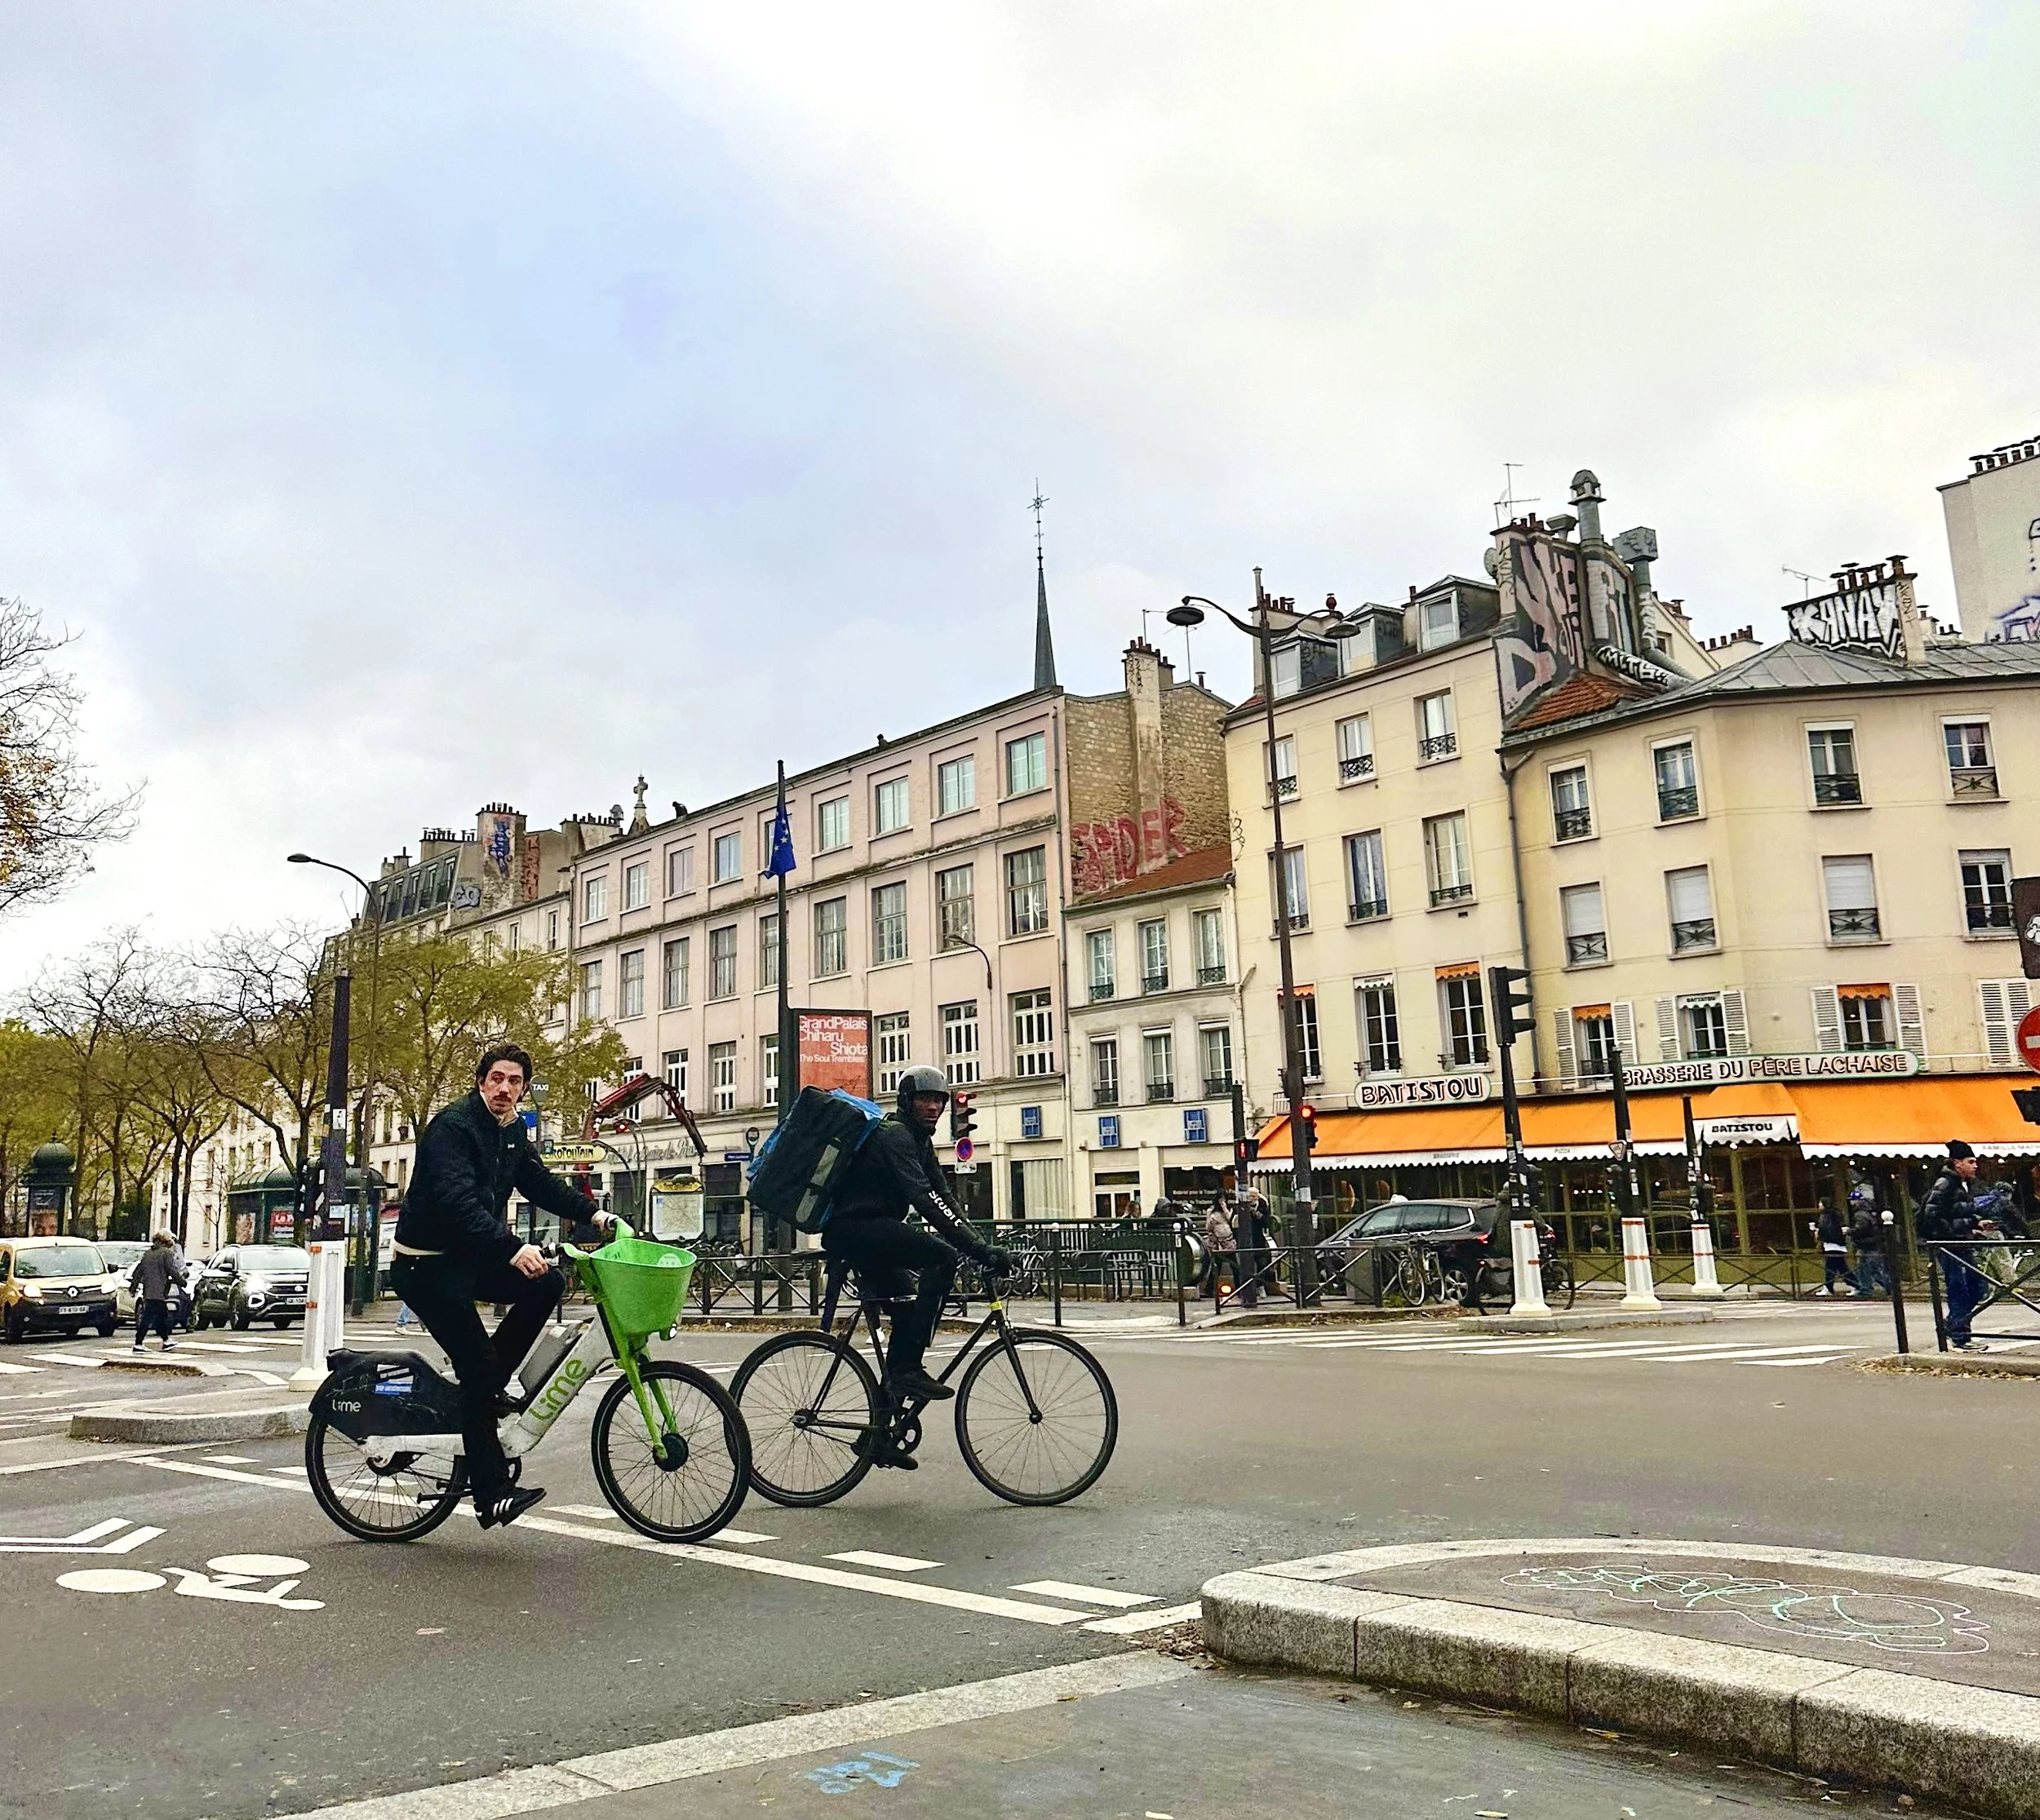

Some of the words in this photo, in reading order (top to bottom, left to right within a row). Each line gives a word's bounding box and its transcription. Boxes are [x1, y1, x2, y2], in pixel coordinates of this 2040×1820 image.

[1071, 796, 1188, 892] SPIDER
[799, 1015, 867, 1030] GrandPalais
[799, 1028, 845, 1042] Chiharu
[830, 1041, 868, 1056] Shiota
[800, 1053, 814, 1062] The
[814, 1053, 831, 1062] Soul
[1622, 1063, 1713, 1086] BRASSERIE
[1718, 1061, 1743, 1079] DU
[1750, 1056, 1801, 1077] PÈRE
[1806, 1053, 1908, 1074] LACHAISE
[532, 1083, 549, 1092] TAXI
[1361, 1075, 1483, 1105] BATISTOU
[1712, 1123, 1773, 1133] BATISTOU
[542, 1145, 594, 1159] ROPOLITAIN
